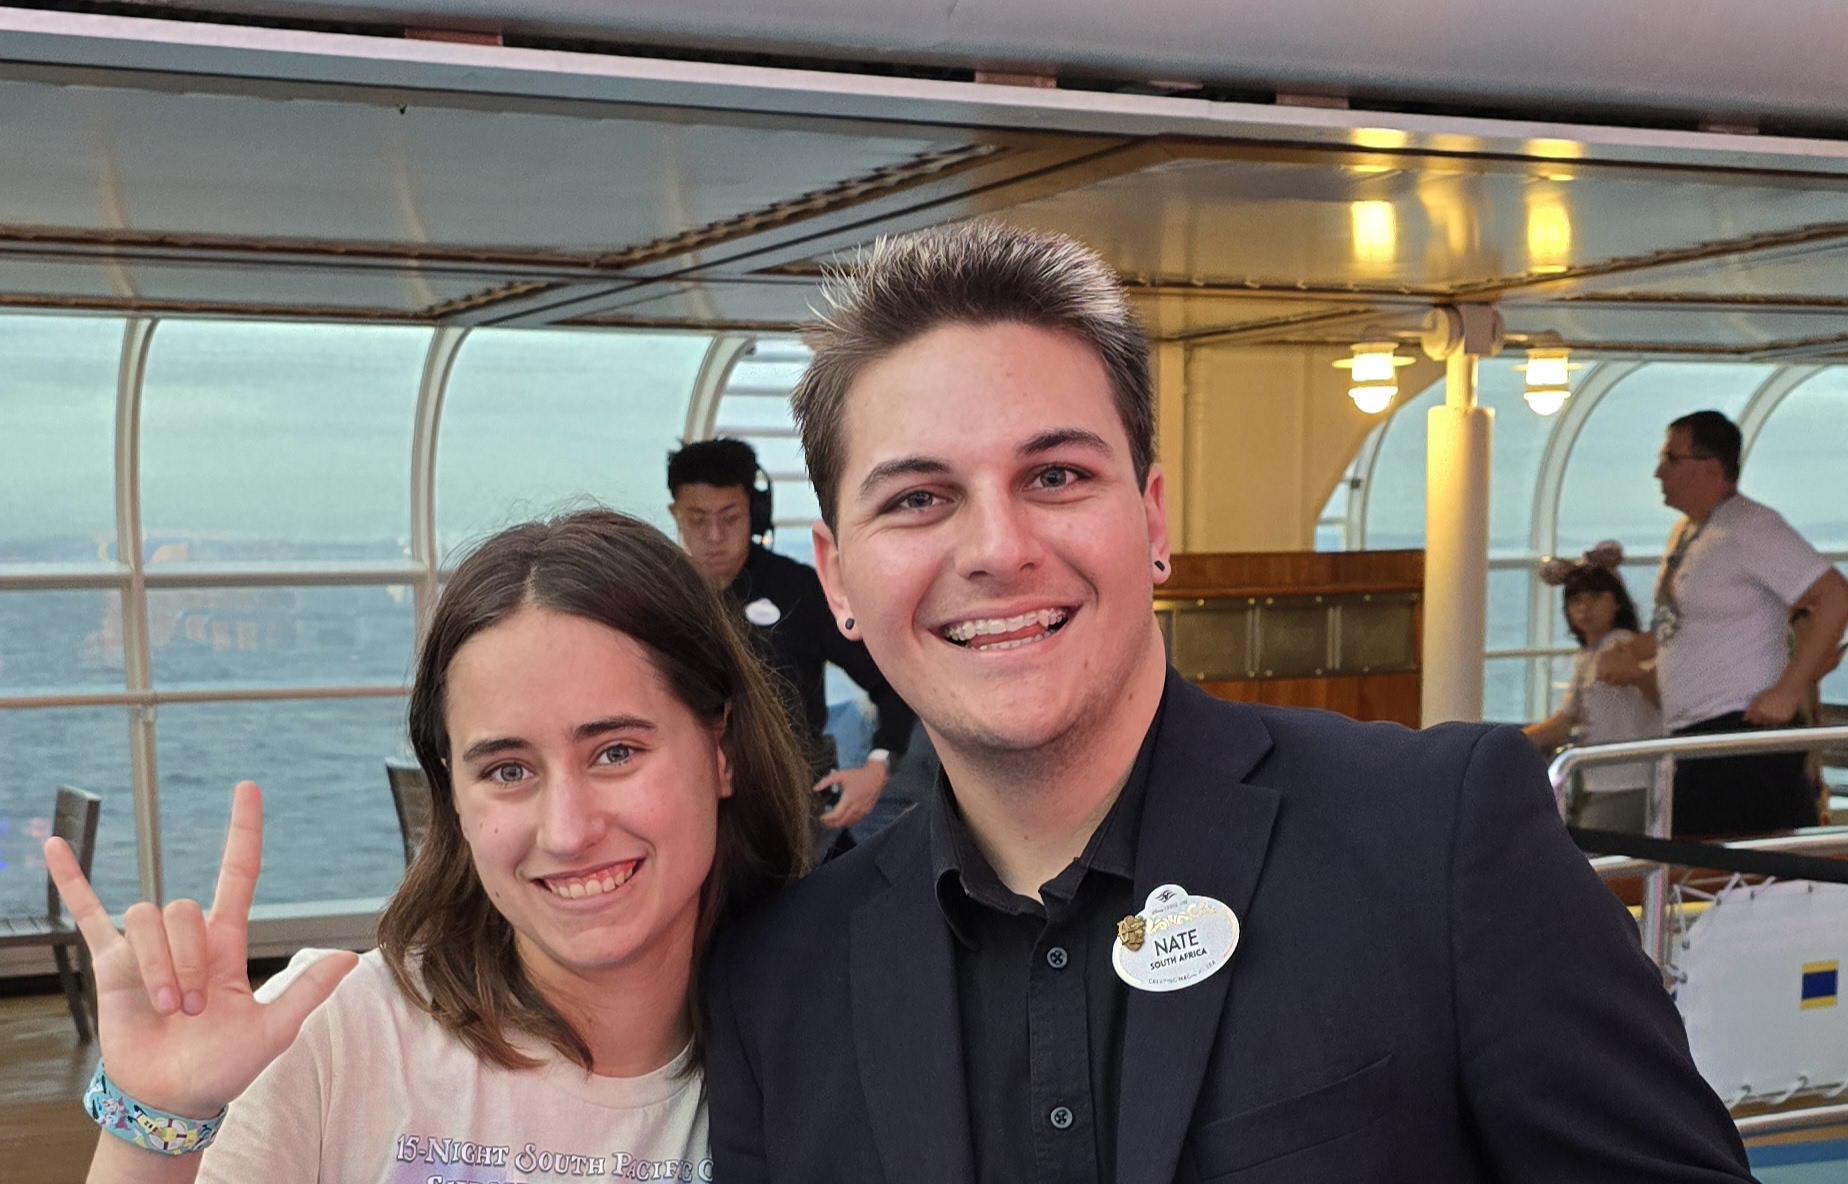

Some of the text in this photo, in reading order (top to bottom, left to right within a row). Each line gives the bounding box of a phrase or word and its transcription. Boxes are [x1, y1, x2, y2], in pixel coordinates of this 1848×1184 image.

[1154, 929, 1199, 957] NATE
[1150, 947, 1207, 970] SOUTH AFRICA
[1178, 973, 1198, 982] MAG
